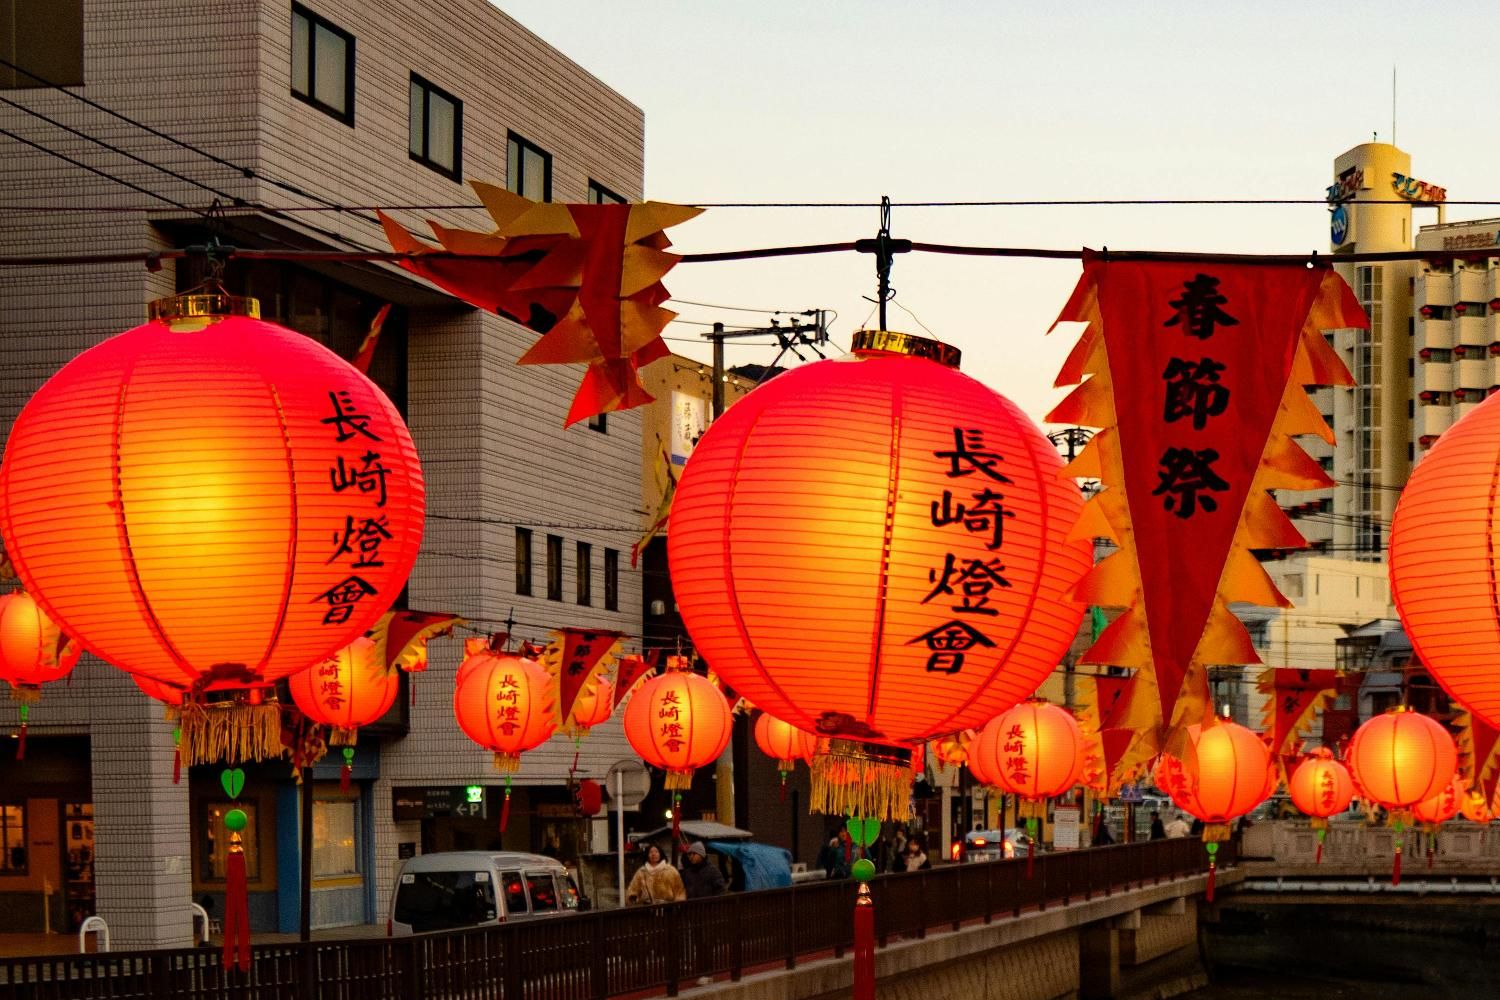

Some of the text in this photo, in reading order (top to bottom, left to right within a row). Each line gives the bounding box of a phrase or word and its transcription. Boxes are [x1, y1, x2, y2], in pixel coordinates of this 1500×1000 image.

[1152, 273, 1241, 520] 春節祭
[308, 391, 394, 626] 長崎燈會
[903, 427, 1016, 676] 長崎燈會
[497, 674, 521, 736] 長崎燈會
[659, 690, 685, 753] 長崎燈會
[1004, 724, 1031, 785] 長崎燈會
[469, 803, 480, 816] P
